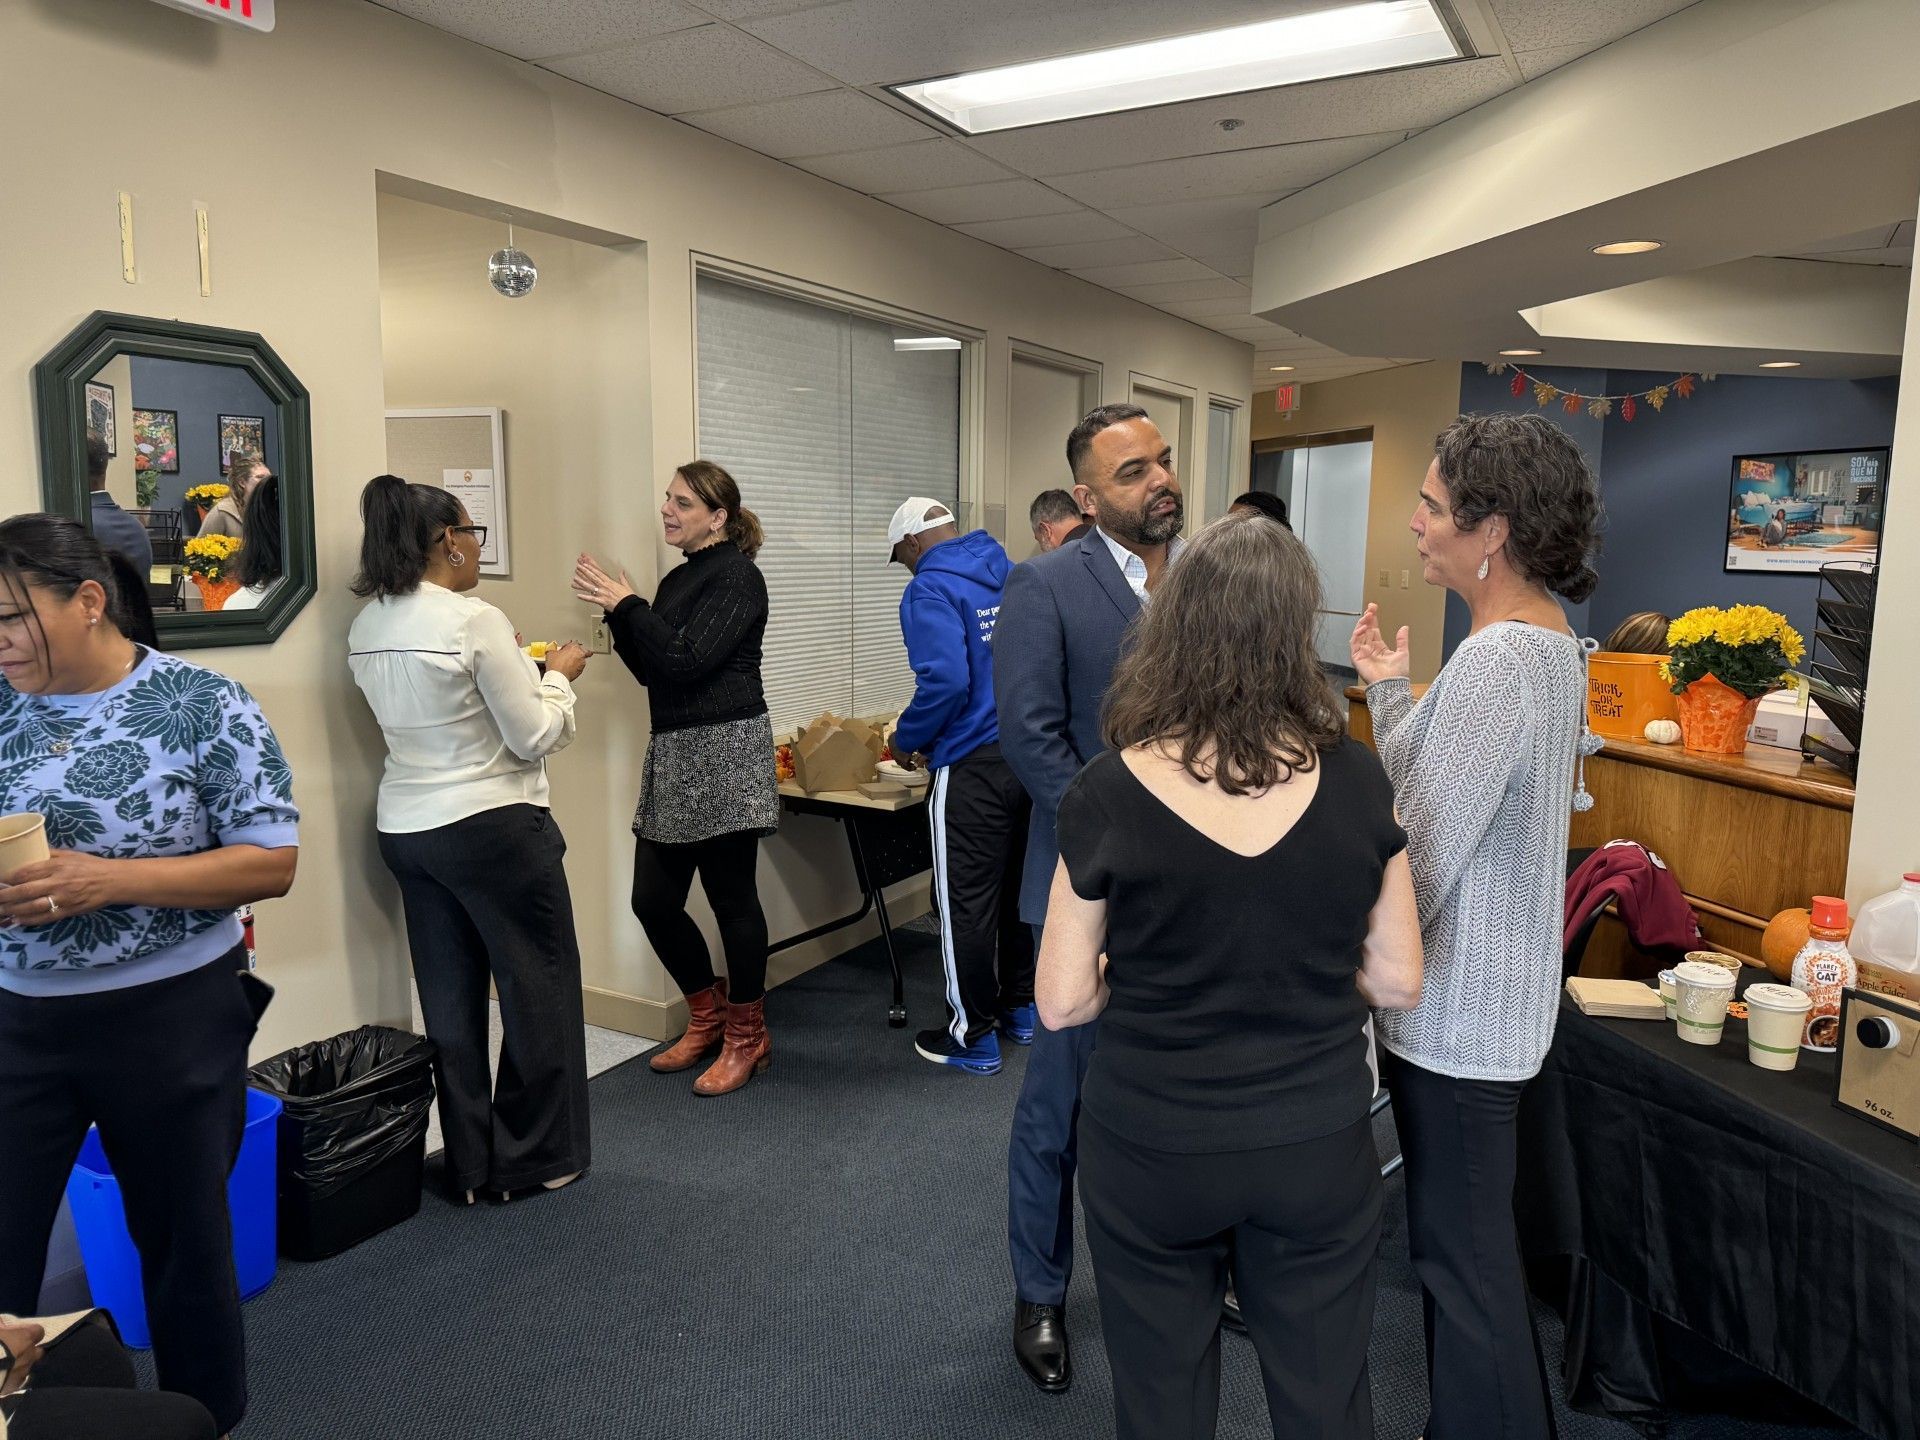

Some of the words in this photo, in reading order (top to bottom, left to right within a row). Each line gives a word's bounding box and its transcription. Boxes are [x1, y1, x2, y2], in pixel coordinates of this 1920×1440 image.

[1278, 386, 1293, 410] EXIT
[1851, 456, 1868, 467] SOY
[1850, 467, 1865, 476] QUE
[976, 608, 990, 618] Dear
[980, 621, 989, 630] the
[1589, 678, 1623, 698] TRICK
[1600, 695, 1613, 706] OR
[1590, 700, 1623, 717] TREAT
[1816, 963, 1838, 971] PLANET
[1816, 971, 1838, 982] OAT
[1856, 977, 1879, 991] Apple
[1881, 985, 1906, 998] Cider
[1865, 1099, 1878, 1112] 96
[1880, 1108, 1894, 1120] oz.
